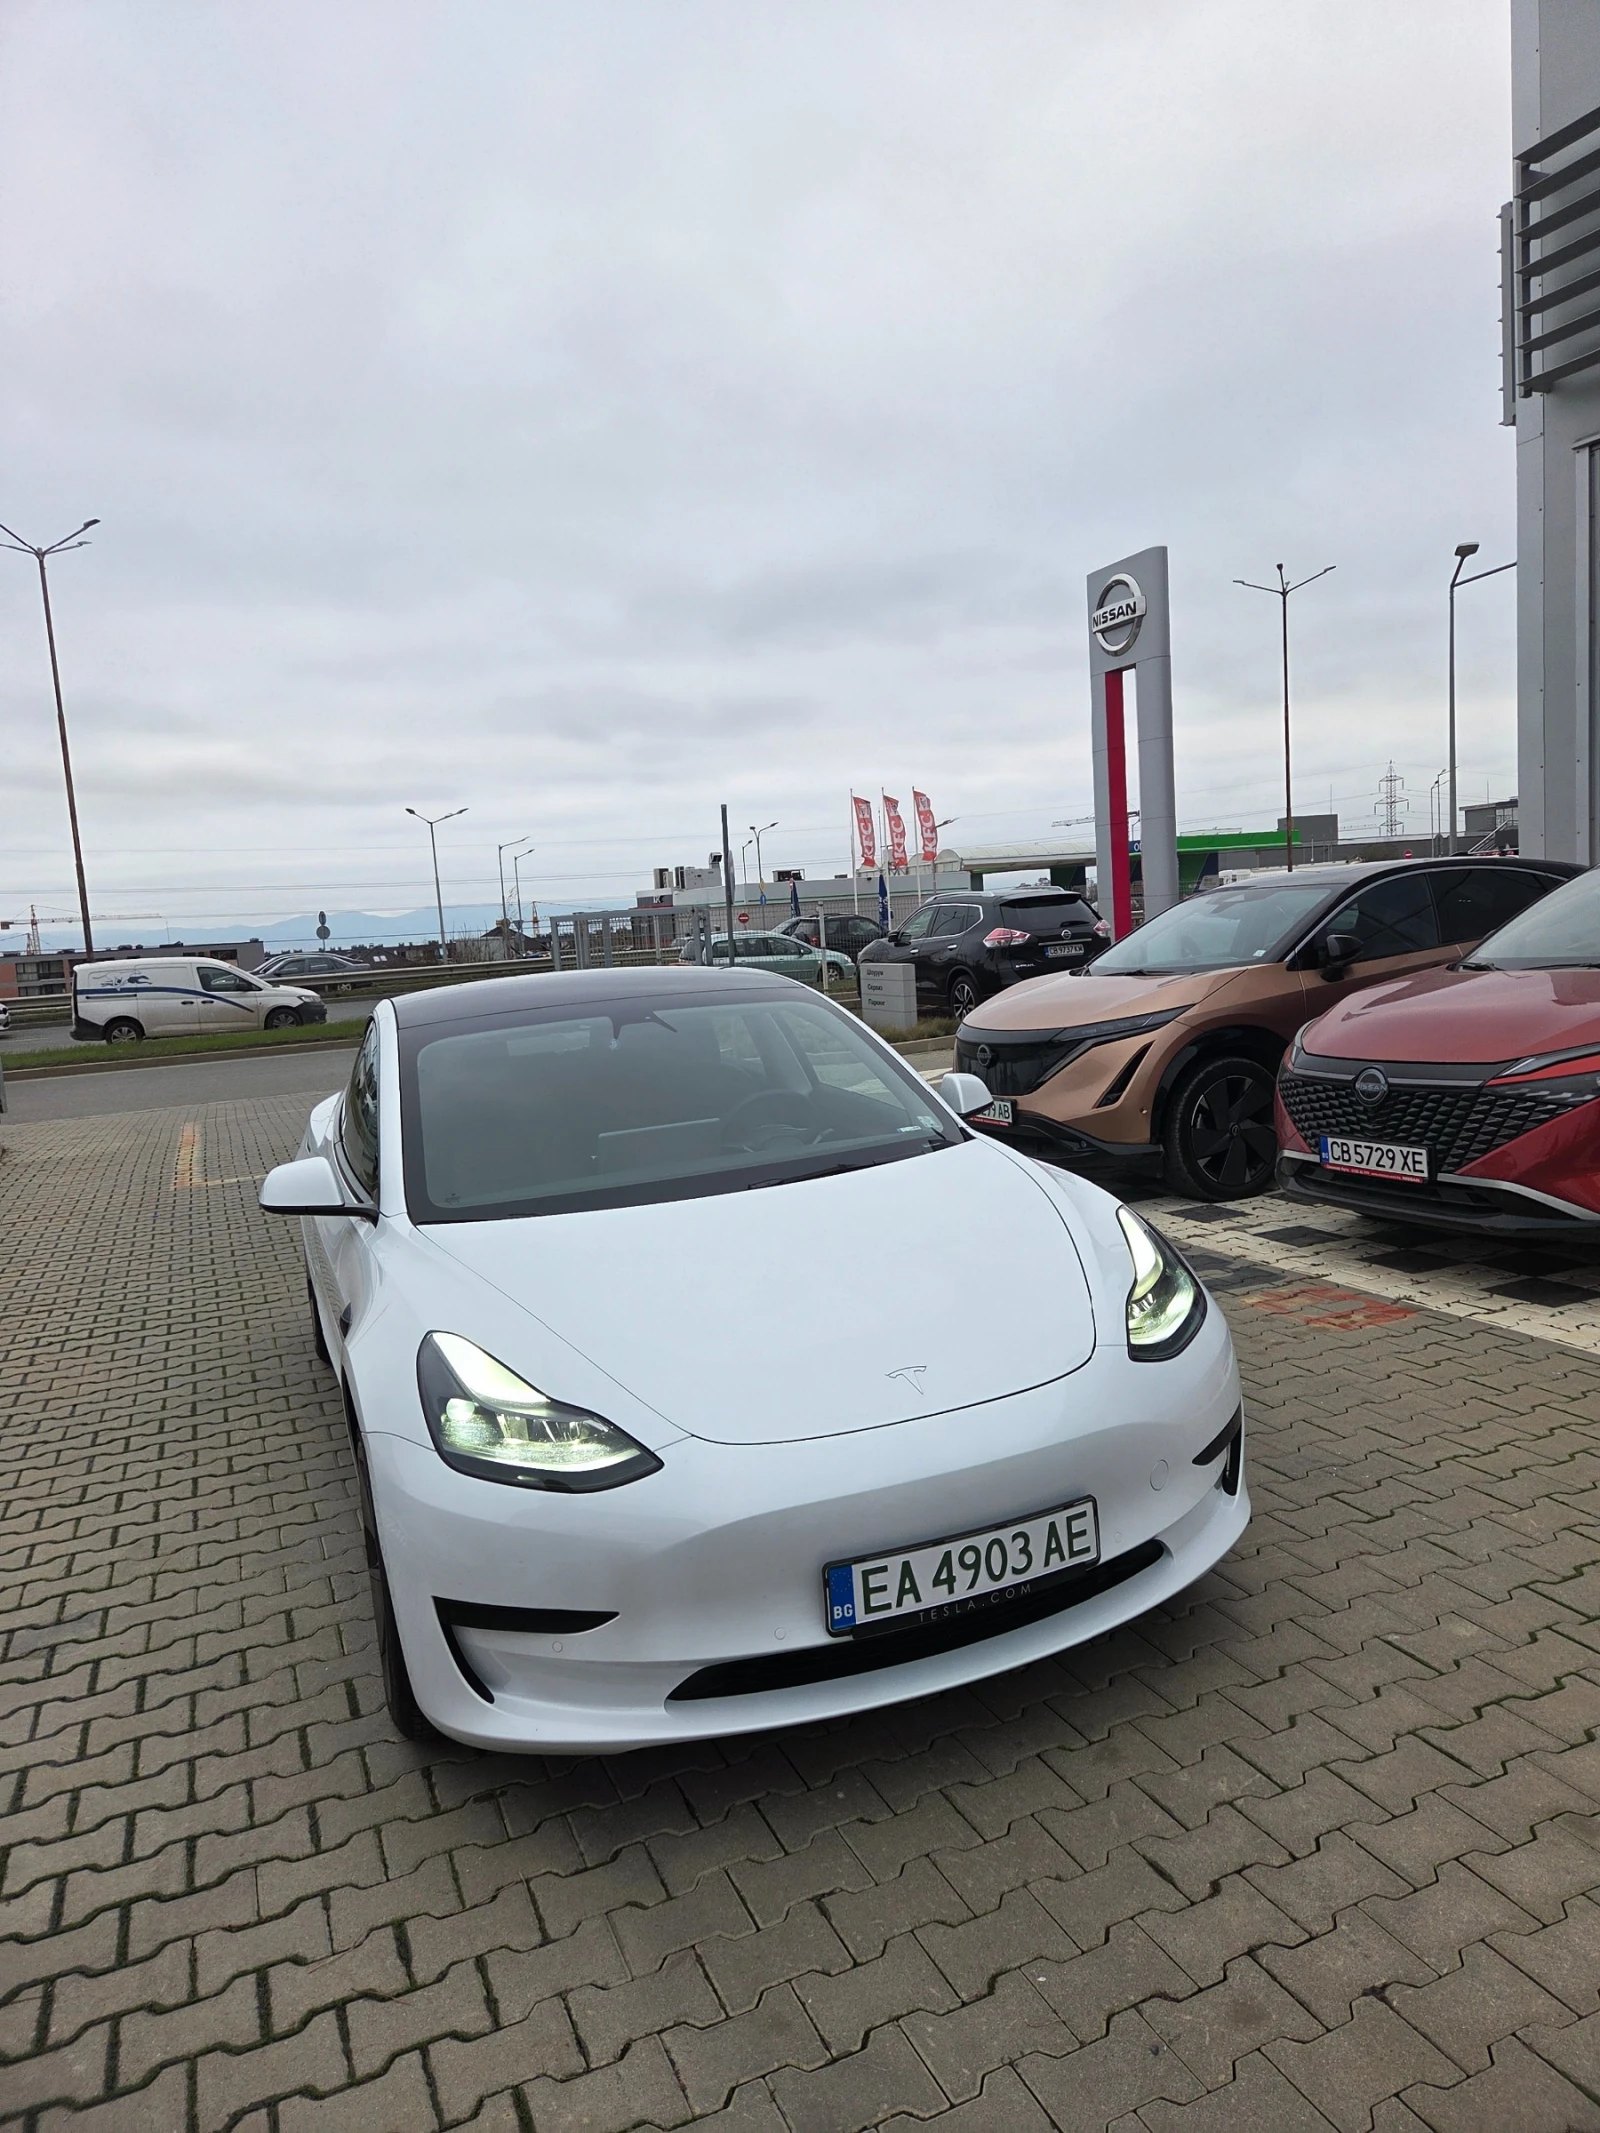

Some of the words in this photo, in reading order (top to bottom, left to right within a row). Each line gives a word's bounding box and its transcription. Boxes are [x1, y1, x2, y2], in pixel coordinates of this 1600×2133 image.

[1092, 601, 1137, 629] NISSAN
[860, 822, 875, 860] KFC
[890, 820, 906, 860] KFC
[920, 813, 937, 853] KFC
[1355, 1082, 1388, 1091] NISSAN
[998, 1103, 1010, 1119] AB
[1330, 1141, 1352, 1162] CB
[1354, 1144, 1396, 1169] 5729
[1400, 1149, 1425, 1174] XE
[861, 1560, 922, 1615] EA
[932, 1530, 1033, 1595] 4903
[1043, 1510, 1091, 1568] AE
[833, 1604, 853, 1619] BG
[919, 1584, 1032, 1622] TESLA.COM
